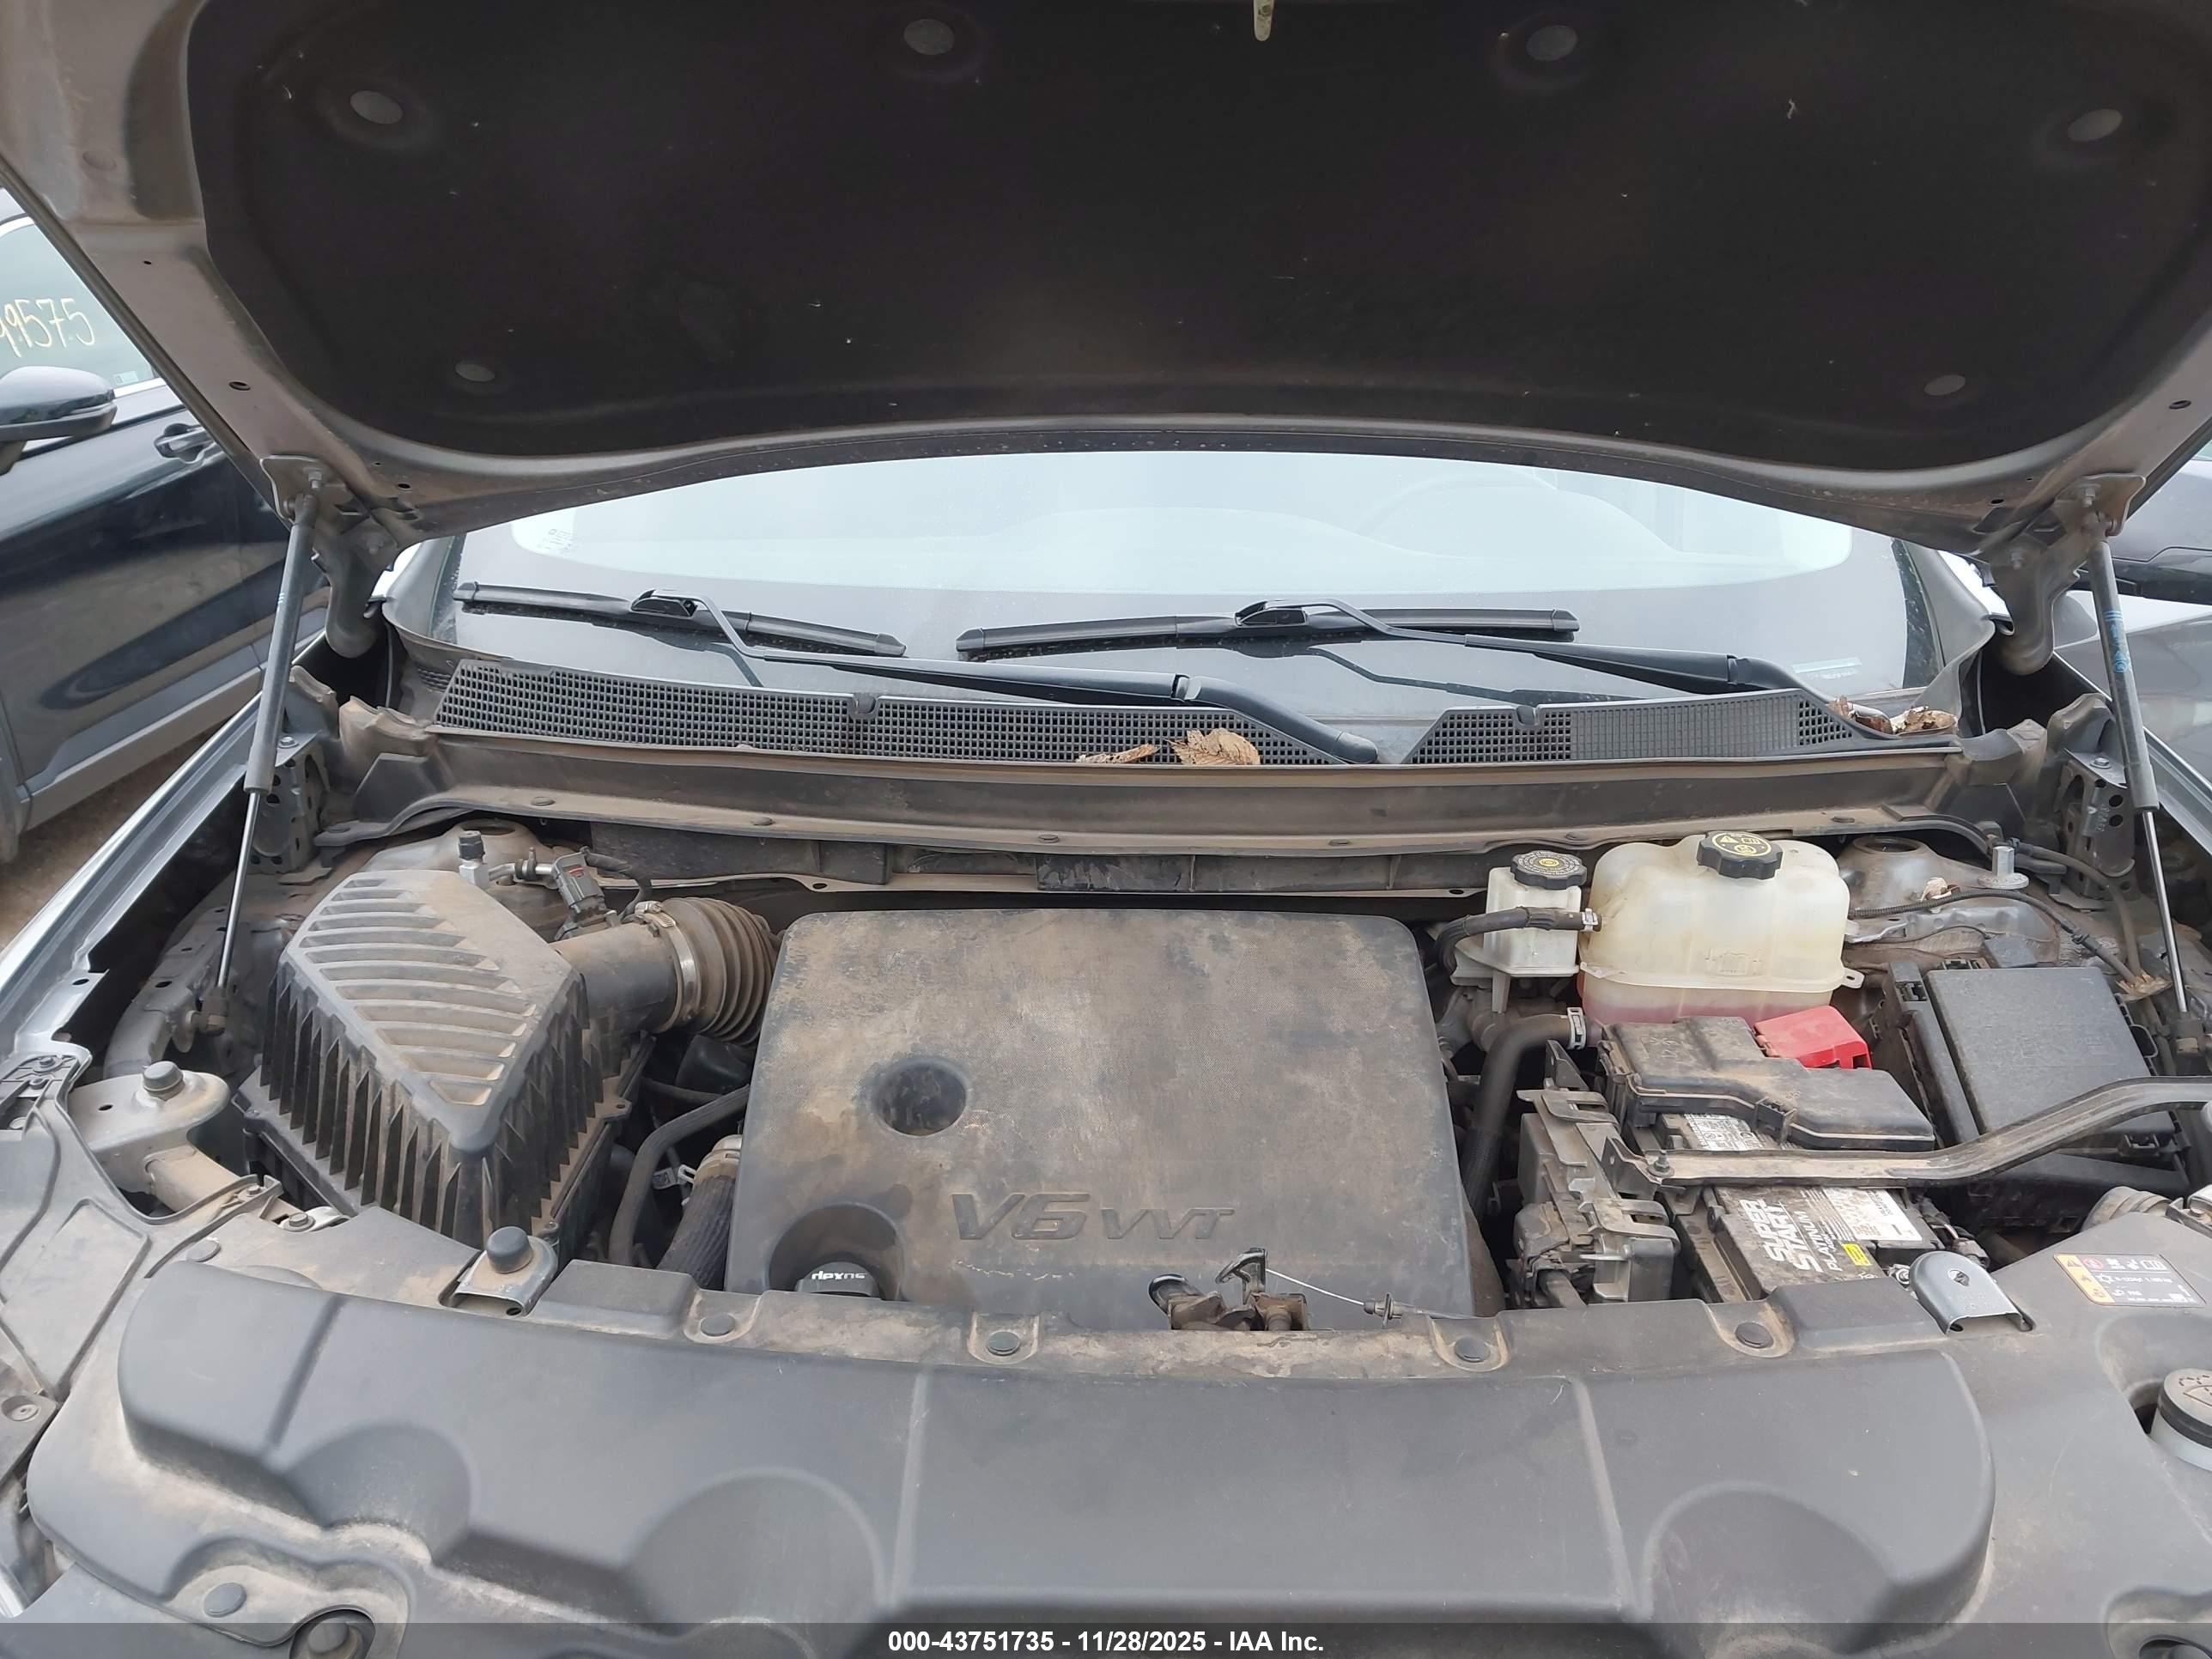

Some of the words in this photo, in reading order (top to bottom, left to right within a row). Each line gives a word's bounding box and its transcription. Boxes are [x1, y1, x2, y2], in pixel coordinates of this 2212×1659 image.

[951, 1193, 1091, 1240] V6
[1100, 1207, 1235, 1240] VVT
[1739, 1199, 1786, 1261] SUPER
[1759, 1199, 1824, 1273] START
[1794, 1211, 1844, 1272] PLATINUM
